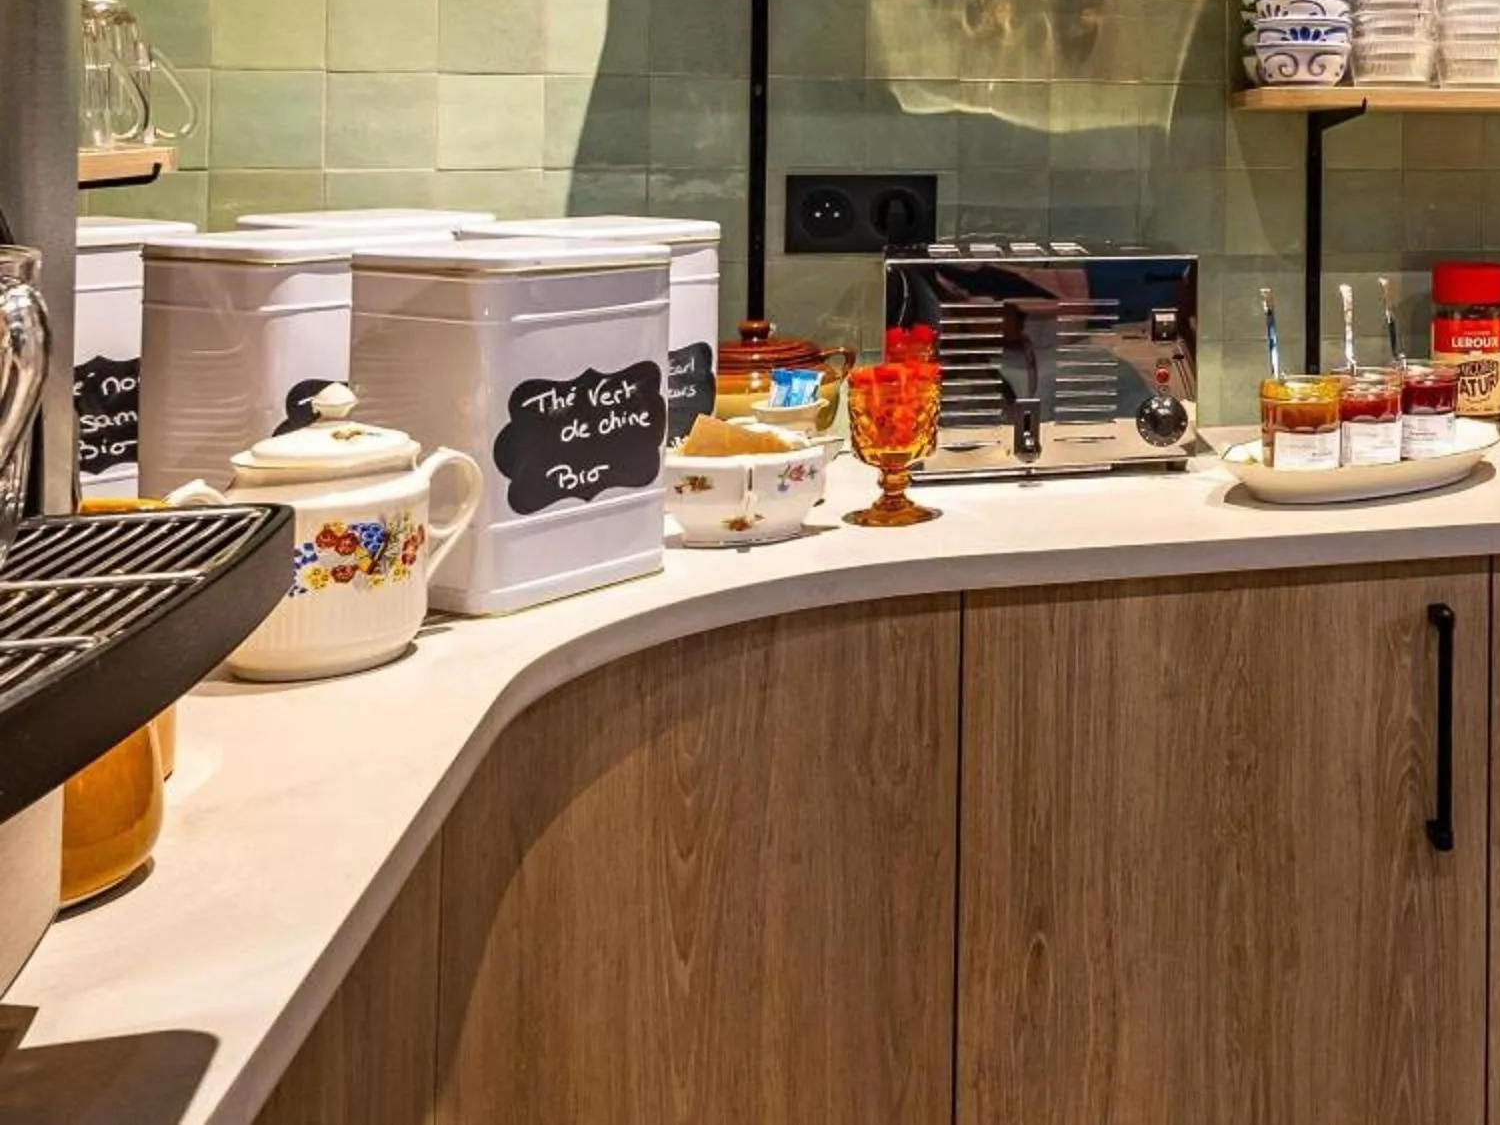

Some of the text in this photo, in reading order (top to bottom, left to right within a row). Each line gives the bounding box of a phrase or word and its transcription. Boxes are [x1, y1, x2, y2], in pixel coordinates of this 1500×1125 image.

[1451, 336, 1500, 349] LEROUX
[521, 378, 637, 413] Thé Vert
[1459, 374, 1498, 398] ATUR
[560, 410, 651, 442] de chine
[545, 464, 610, 490] Bio
